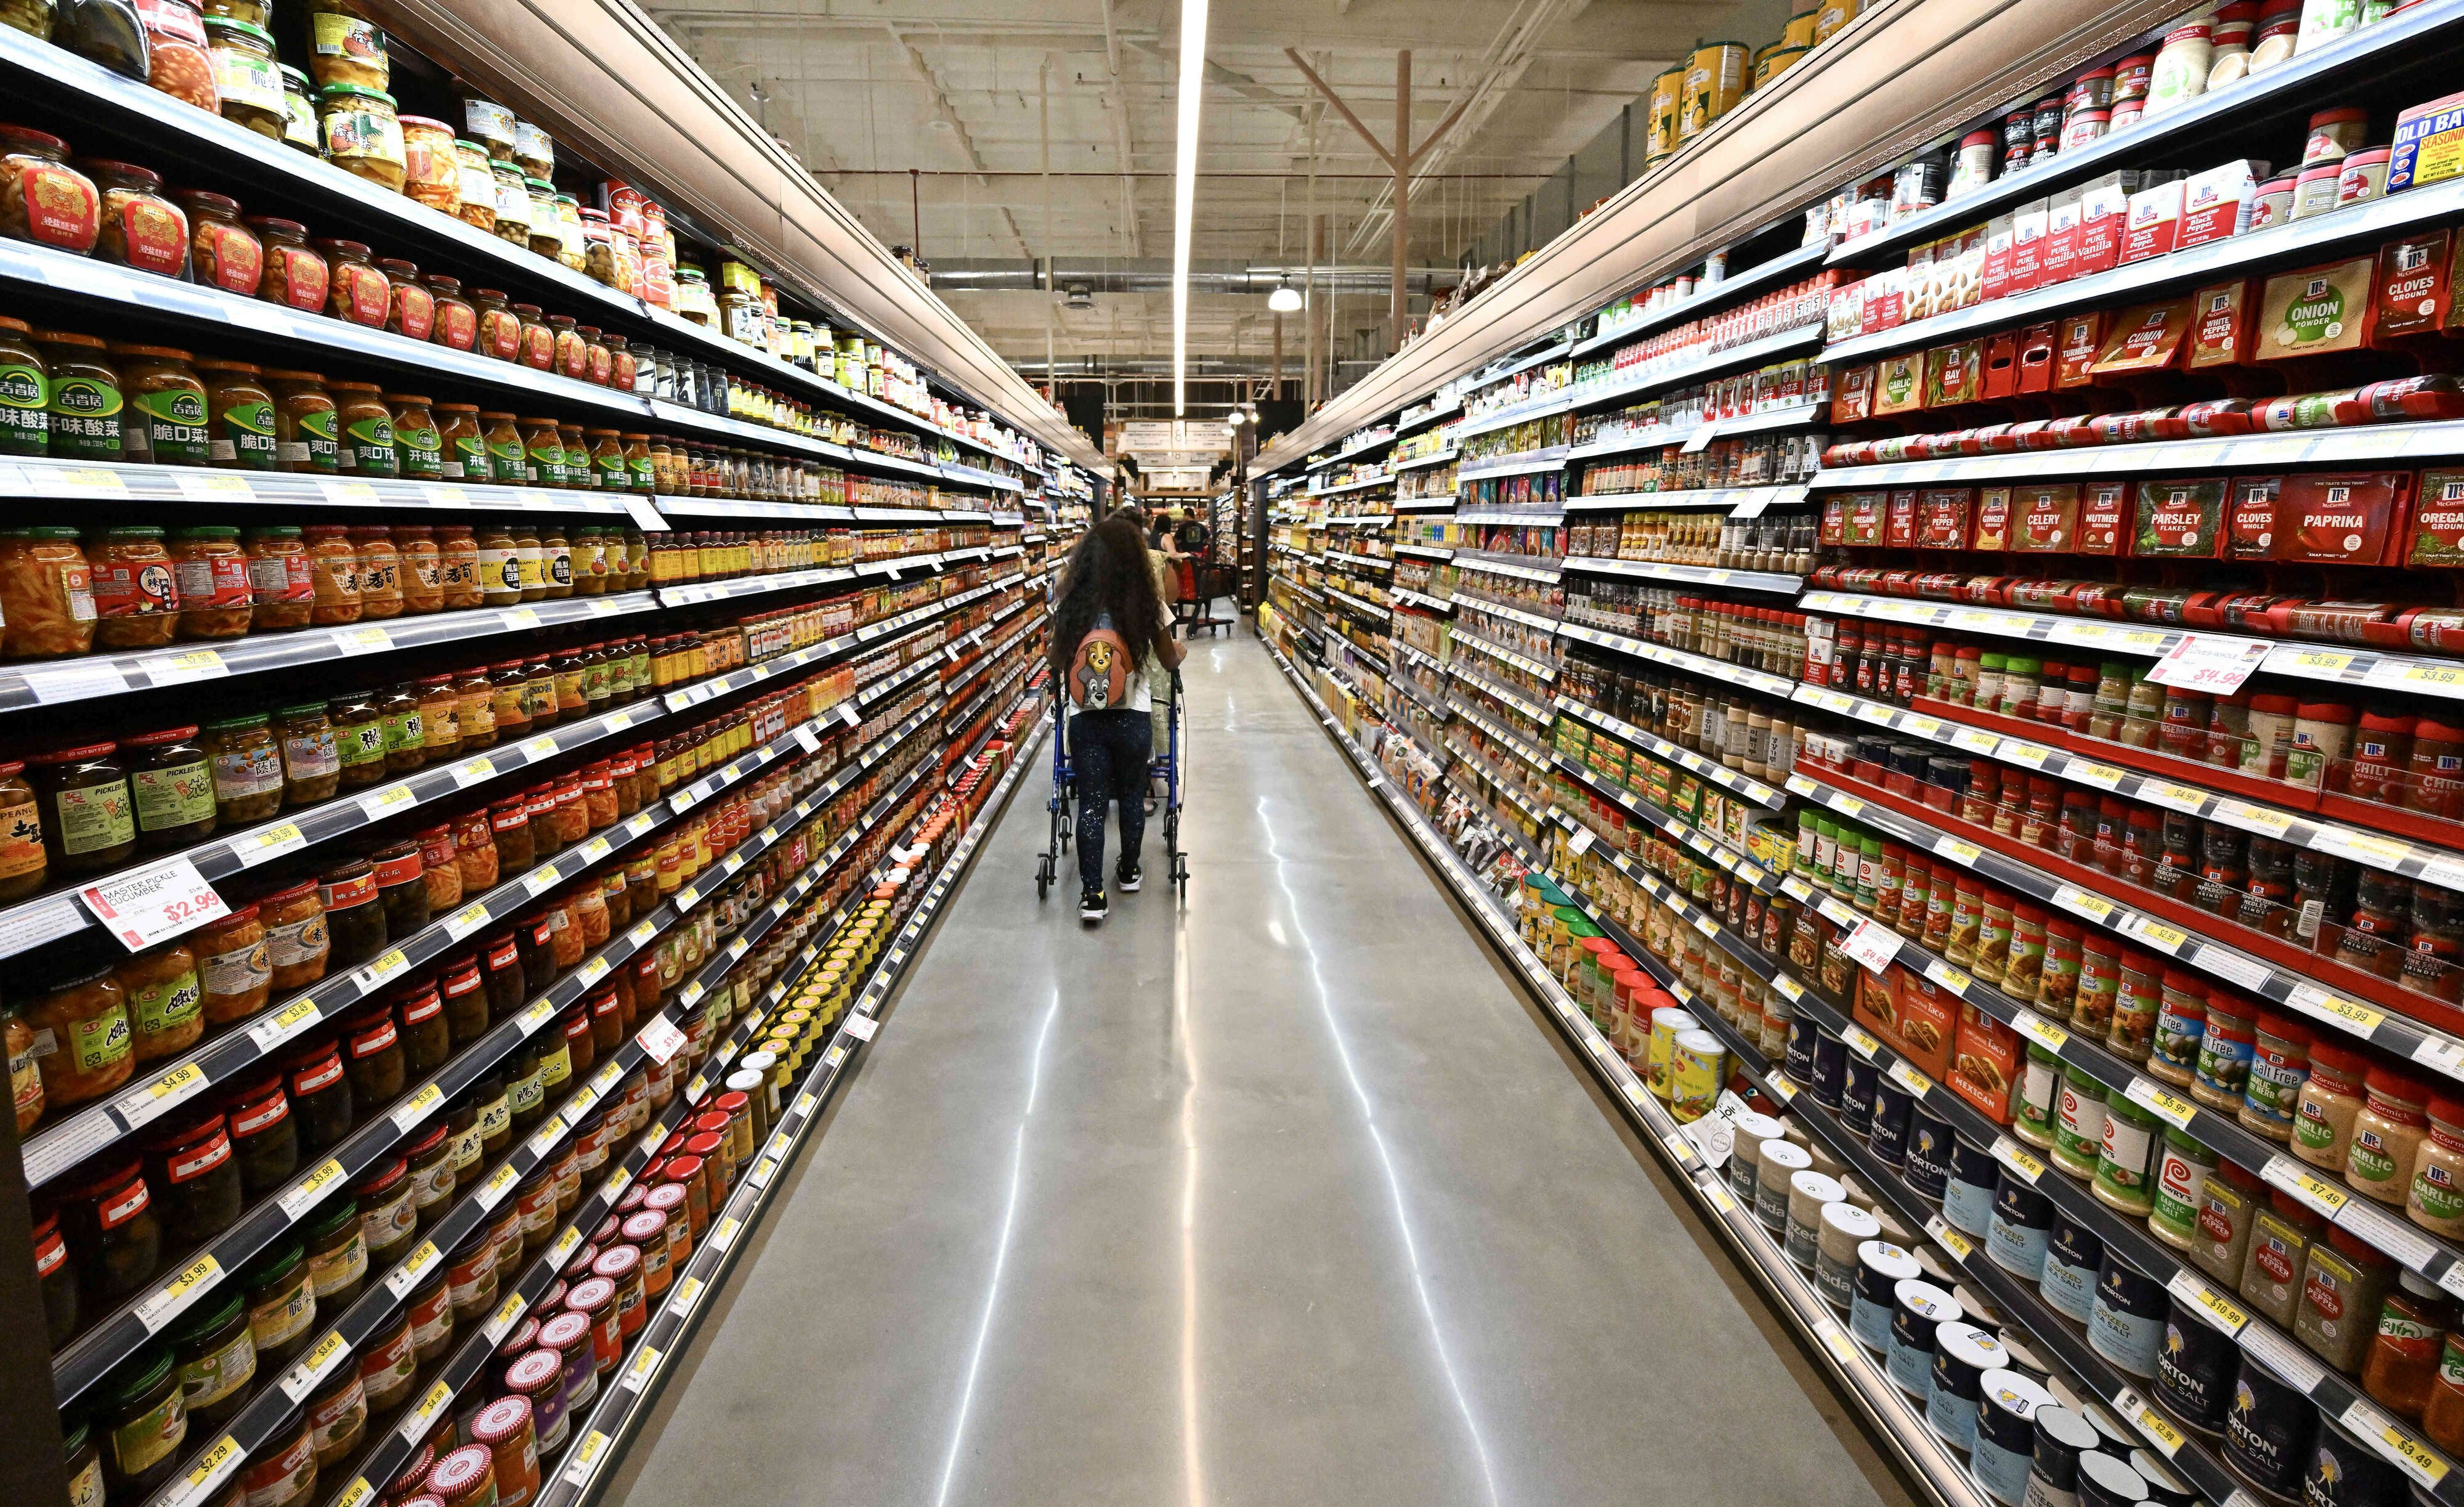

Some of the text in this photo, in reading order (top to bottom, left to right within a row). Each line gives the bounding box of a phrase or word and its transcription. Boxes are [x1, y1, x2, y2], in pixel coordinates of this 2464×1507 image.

[2397, 120, 2431, 144] OLD
[2342, 183, 2359, 191] SAGE
[2187, 221, 2214, 232] Pepper
[2190, 216, 2211, 225] Black
[2086, 233, 2106, 244] PURE
[2130, 238, 2154, 248] Pepper
[2133, 234, 2152, 243] Black
[2051, 244, 2070, 255] PURE
[2078, 240, 2112, 256] Vanilla
[2017, 255, 2035, 266] PURE
[2044, 250, 2075, 267] Vanilla
[2083, 251, 2104, 261] EXTRACT
[1989, 265, 2005, 274] PURE
[2010, 262, 2040, 276] Vanilla
[2049, 261, 2069, 270] EXTRACT
[1983, 272, 2009, 285] Vanilla
[2015, 272, 2033, 280] EXTRACT
[2389, 277, 2434, 295] CLOVES
[2393, 290, 2428, 301] GROUND
[2292, 301, 2339, 320] ONION
[2203, 323, 2231, 335] PEPPER
[2207, 317, 2230, 327] WHITE
[2295, 317, 2330, 328] POWDER
[2128, 330, 2165, 344] CUMIN
[2203, 331, 2228, 340] GROUND
[2063, 345, 2094, 358] TURMERIC
[2069, 354, 2087, 362] GROUND
[1945, 369, 1961, 380] BAY
[0, 381, 38, 397] 吉香居
[1889, 378, 1911, 389] GARLIC
[61, 393, 102, 407] 吉香居
[174, 404, 202, 415] 吉香居
[1853, 516, 1875, 524] OREGANO
[1932, 518, 1954, 527] PEPPER
[1982, 514, 2005, 524] GINGER
[2027, 514, 2060, 525] CELERY
[2086, 514, 2118, 523] NUTMEG
[2151, 514, 2201, 525] PARSLEY
[2237, 513, 2272, 524] CLOVES
[2304, 515, 2363, 528] PAPRIKA
[2308, 657, 2338, 667] $3.99
[2194, 668, 2245, 685] $4.99
[2421, 671, 2455, 682] $3.99
[166, 766, 195, 777] PICKLED
[2096, 769, 2114, 778] $6.49
[95, 785, 121, 795] PICKLED
[389, 790, 405, 800] $7.49
[2174, 789, 2197, 801] $4.99
[2255, 811, 2281, 824] $2.99
[269, 827, 291, 842] $5.99
[103, 871, 177, 900] MASTER PICKLE
[109, 883, 164, 906] CUCUMBER
[286, 892, 302, 901] MOVES
[163, 891, 219, 922] $2.99
[2085, 899, 2104, 911] $3.99
[468, 908, 482, 919] $3.49
[219, 916, 245, 927] PRESSED
[2158, 929, 2178, 941] $2.99
[1826, 942, 1847, 959] BROWN
[383, 954, 399, 966] $3.49
[1862, 949, 1888, 967] $4.49
[1950, 974, 1966, 985] $5.49
[290, 1003, 308, 1017] $3.49
[1928, 1004, 1945, 1019] Taco
[2337, 1004, 2369, 1021] $3.99
[665, 1031, 681, 1047] $3.49
[2040, 1025, 2059, 1040] $5.49
[1987, 1039, 2006, 1057] Taco
[162, 1068, 190, 1089] $4.99
[2254, 1060, 2298, 1085] Salt Free
[2250, 1073, 2271, 1091] GARLIC
[418, 1089, 434, 1105] $3.99
[1955, 1077, 1995, 1108] MEXICAN
[2256, 1084, 2275, 1099] HERB
[2162, 1097, 2186, 1114] $5.99
[2295, 1115, 2331, 1139] GARLIC
[1907, 1151, 1948, 1176] MORTON
[2014, 1154, 2036, 1169] $4.49
[2351, 1144, 2393, 1172] GARLIC
[313, 1166, 333, 1184] $3.99
[494, 1169, 509, 1184] $4.49
[1912, 1165, 1931, 1180] SALT
[2162, 1182, 2192, 1202] LAWRY'S
[2311, 1182, 2340, 1203] $7.49
[2414, 1179, 2463, 1209] GARLIC
[1999, 1201, 2025, 1219] MORTON
[2160, 1195, 2184, 1214] GARLIC
[2162, 1206, 2178, 1218] SALT
[2202, 1215, 2229, 1236] PEPPER
[415, 1247, 430, 1262] $3.49
[2054, 1240, 2082, 1260] MORTON
[2259, 1256, 2289, 1277] PEPPER
[179, 1264, 208, 1287] $3.99
[506, 1301, 520, 1317] $4.99
[2210, 1298, 2240, 1323] $10.99
[318, 1338, 336, 1357] $3.49
[427, 1390, 445, 1410] $4.99
[2155, 1423, 2174, 1440] $2.99
[200, 1445, 227, 1472] $2.29
[2398, 1441, 2432, 1468] $3.49
